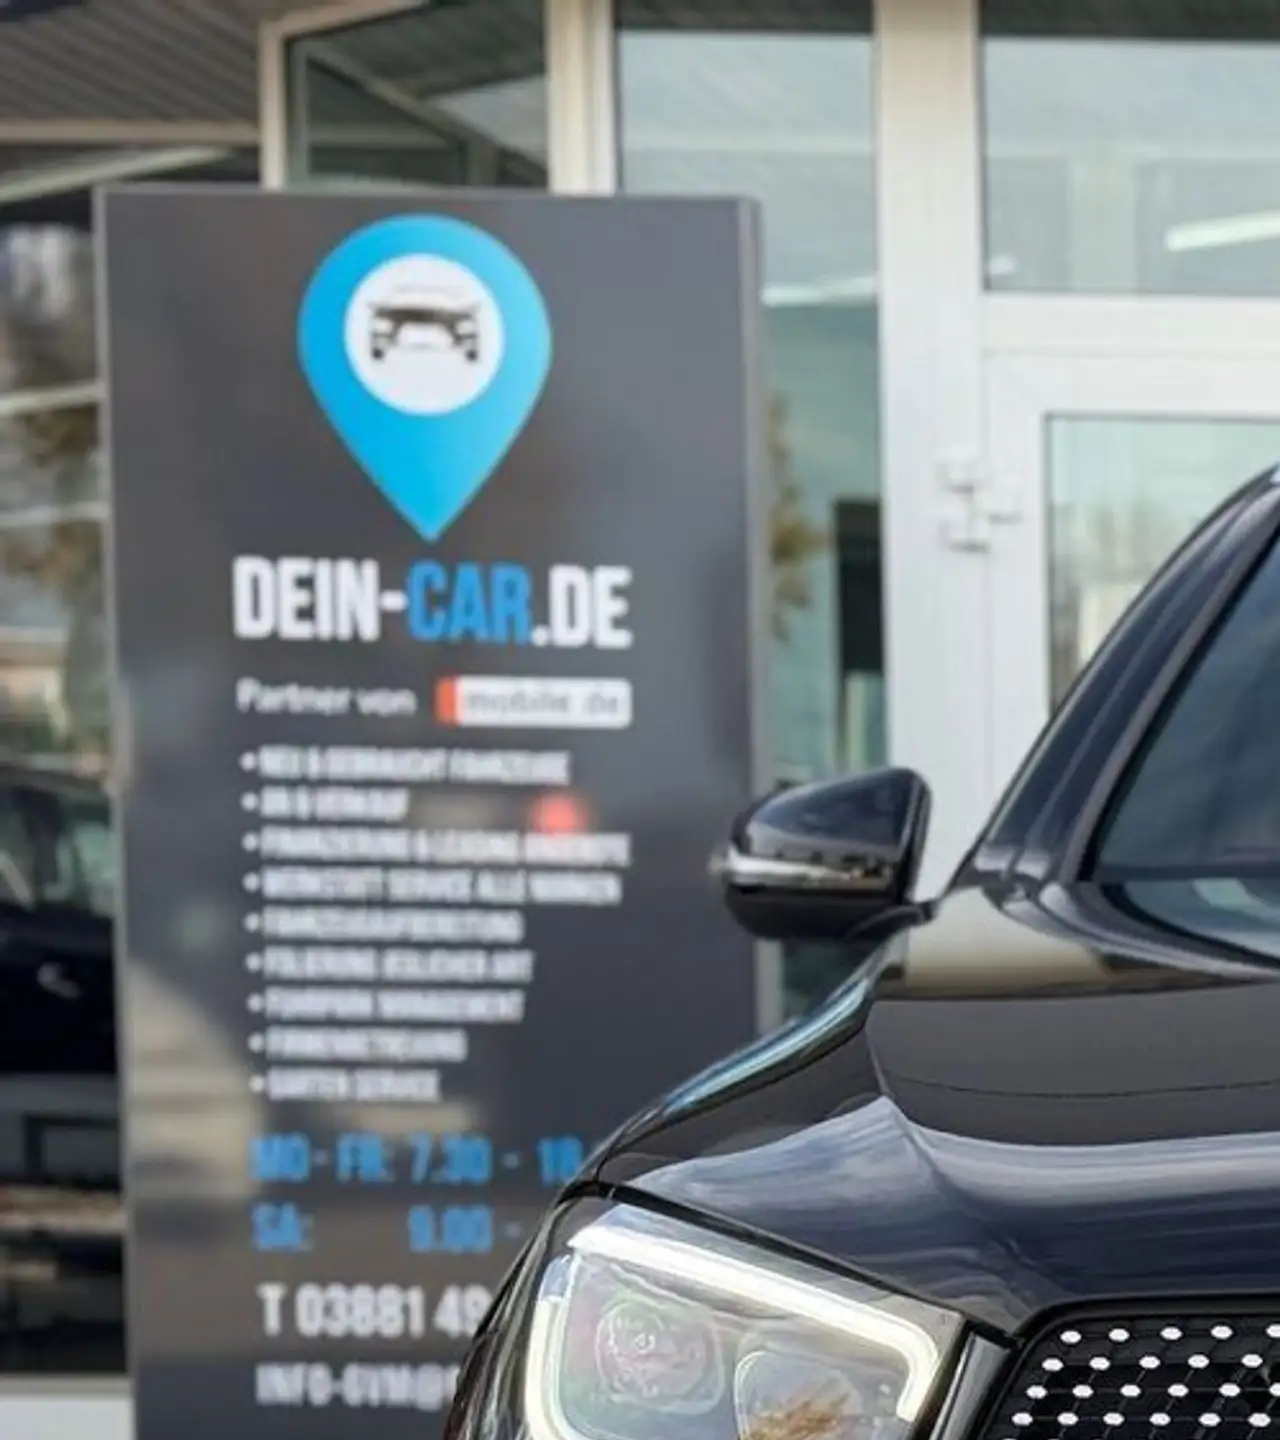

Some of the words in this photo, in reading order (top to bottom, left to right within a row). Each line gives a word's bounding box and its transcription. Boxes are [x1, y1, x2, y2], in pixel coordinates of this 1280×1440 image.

[232, 556, 634, 649] DEIN-CAR.DE
[236, 677, 350, 717] Partner
[356, 686, 418, 717] von
[257, 1282, 286, 1337] T
[294, 1283, 426, 1340] 03881
